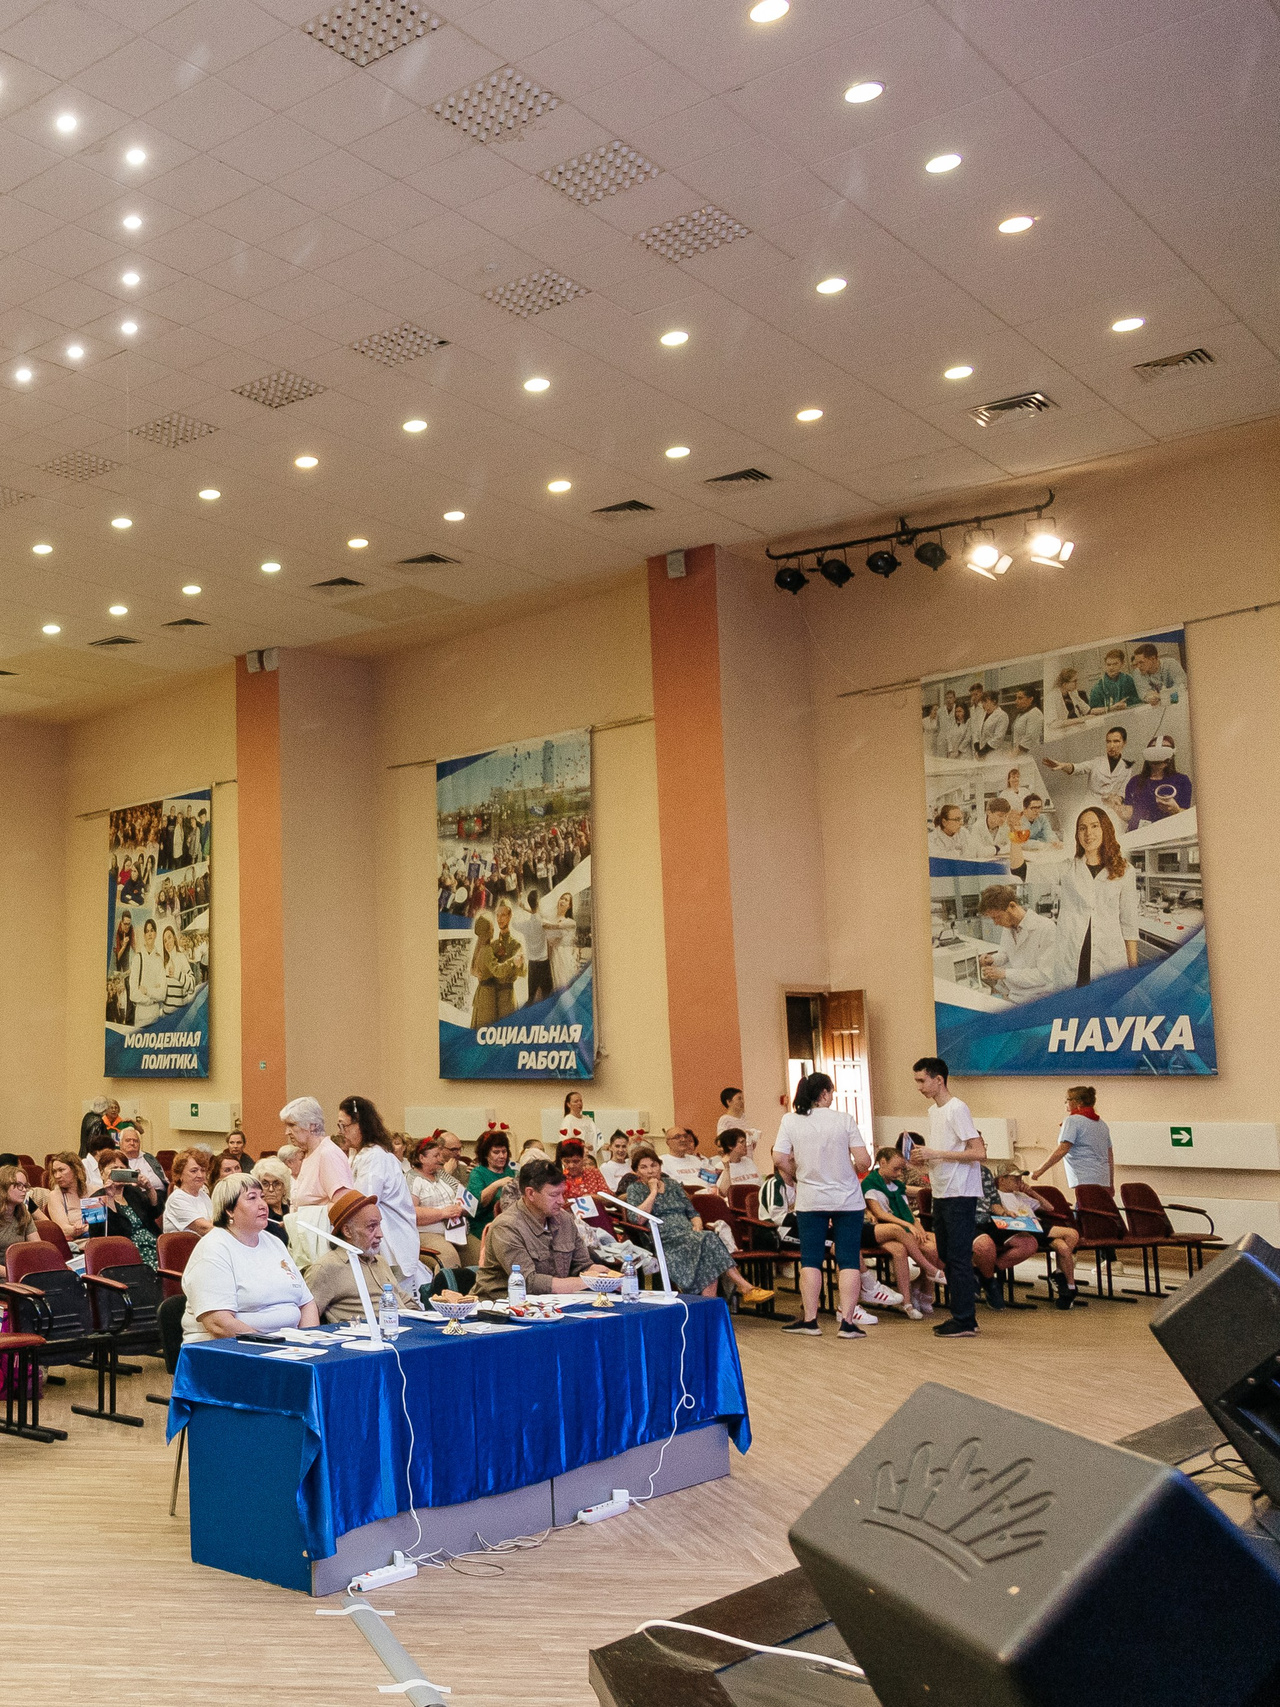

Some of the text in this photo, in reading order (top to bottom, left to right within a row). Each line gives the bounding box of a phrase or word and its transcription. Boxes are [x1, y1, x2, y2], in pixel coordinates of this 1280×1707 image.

[124, 1031, 202, 1050] МОЛОДЕЖНАЯ
[476, 1024, 583, 1047] СОЦИАЛЬНАЯ
[1048, 1015, 1195, 1053] НАУКА
[141, 1054, 198, 1070] ПОЛИТИКА
[517, 1050, 578, 1070] РАБОТА
